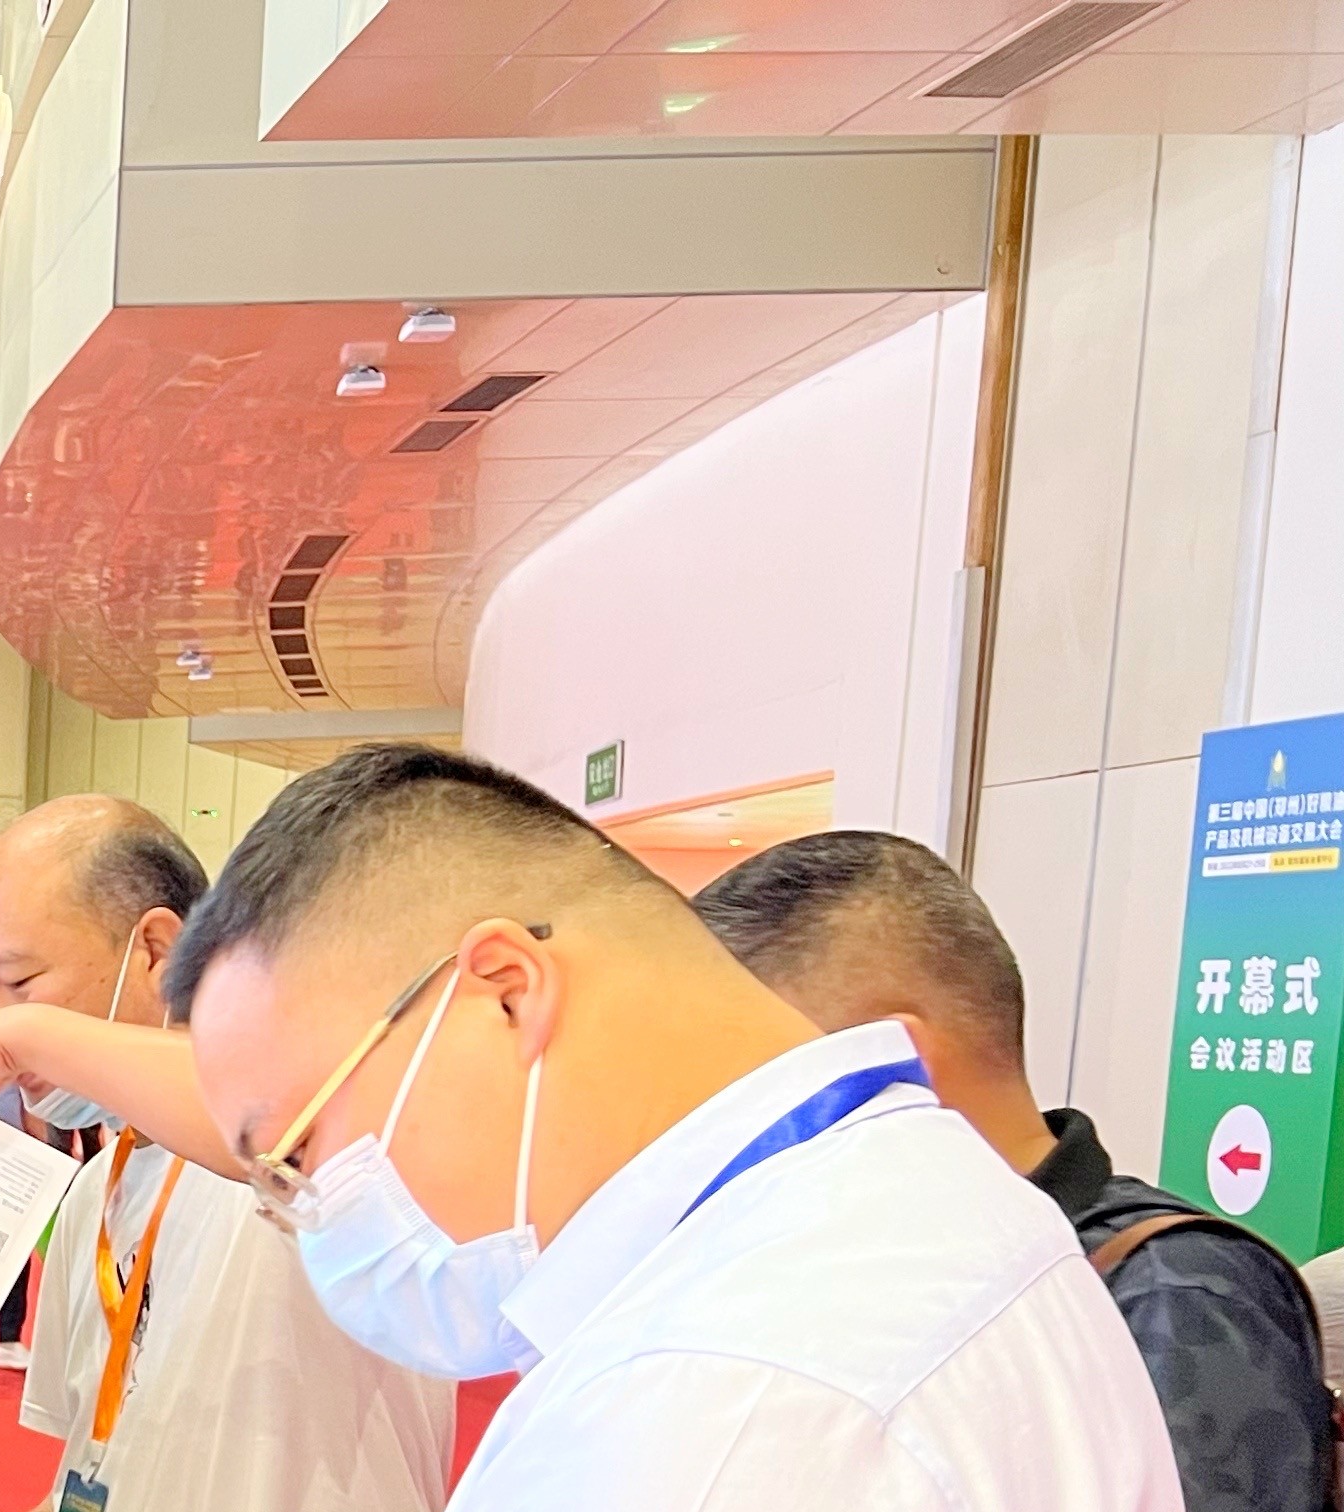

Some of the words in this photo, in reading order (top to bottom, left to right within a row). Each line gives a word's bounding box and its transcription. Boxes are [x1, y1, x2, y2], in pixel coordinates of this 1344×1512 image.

[1196, 955, 1322, 1016] 开幕式
[1190, 1035, 1315, 1075] 会议活动区
